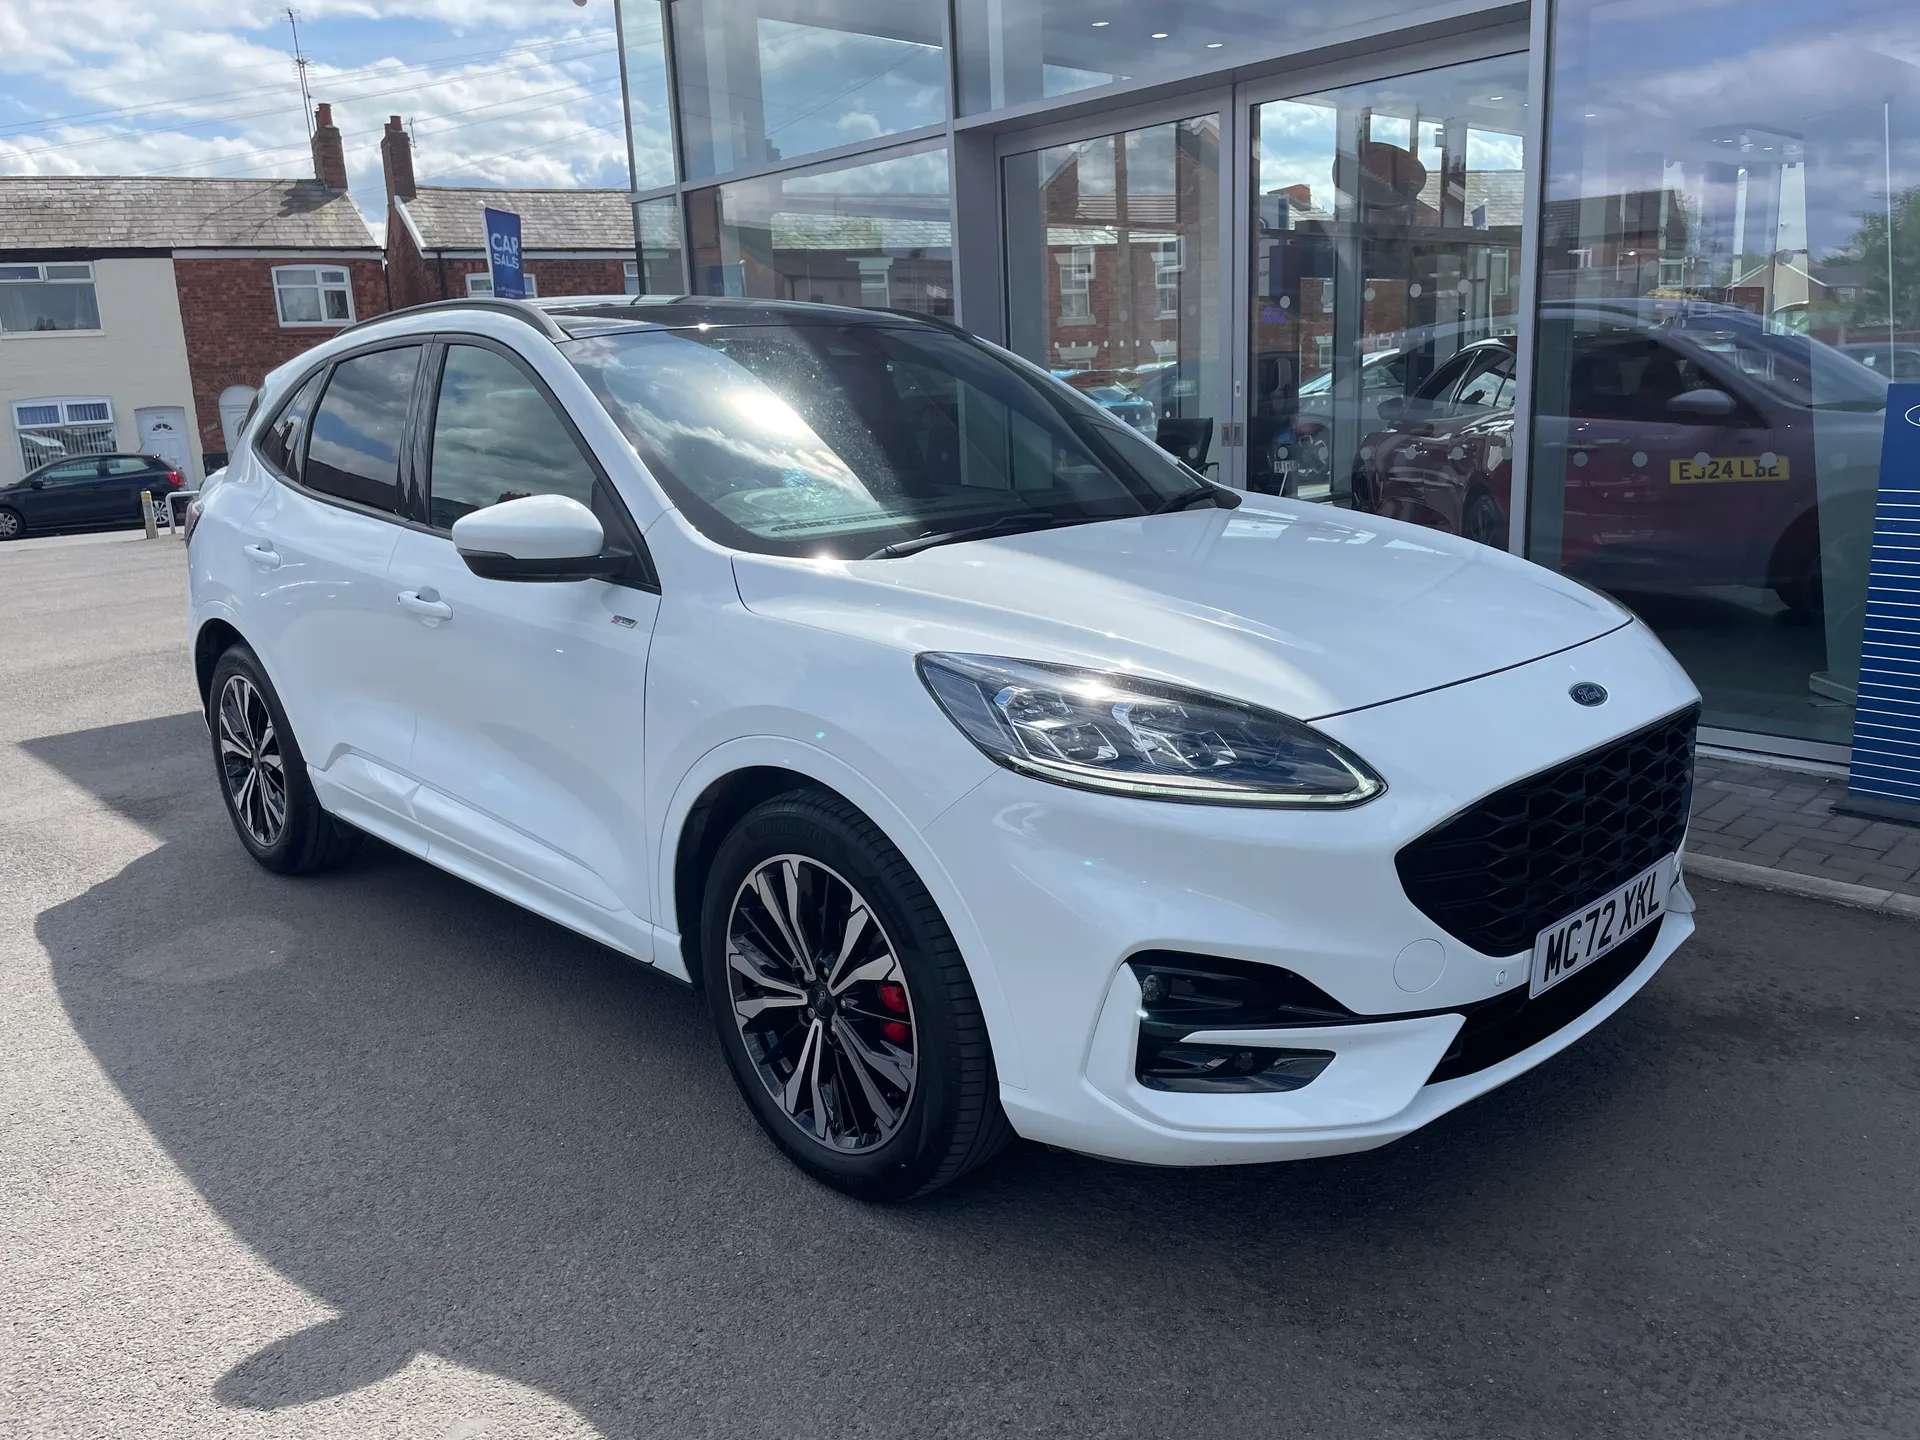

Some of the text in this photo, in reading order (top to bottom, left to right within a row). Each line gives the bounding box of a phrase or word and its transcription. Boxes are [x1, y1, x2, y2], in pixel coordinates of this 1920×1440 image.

[491, 232, 519, 255] CAR
[493, 252, 520, 270] SALS
[1544, 871, 1659, 983] MC72 XKL
